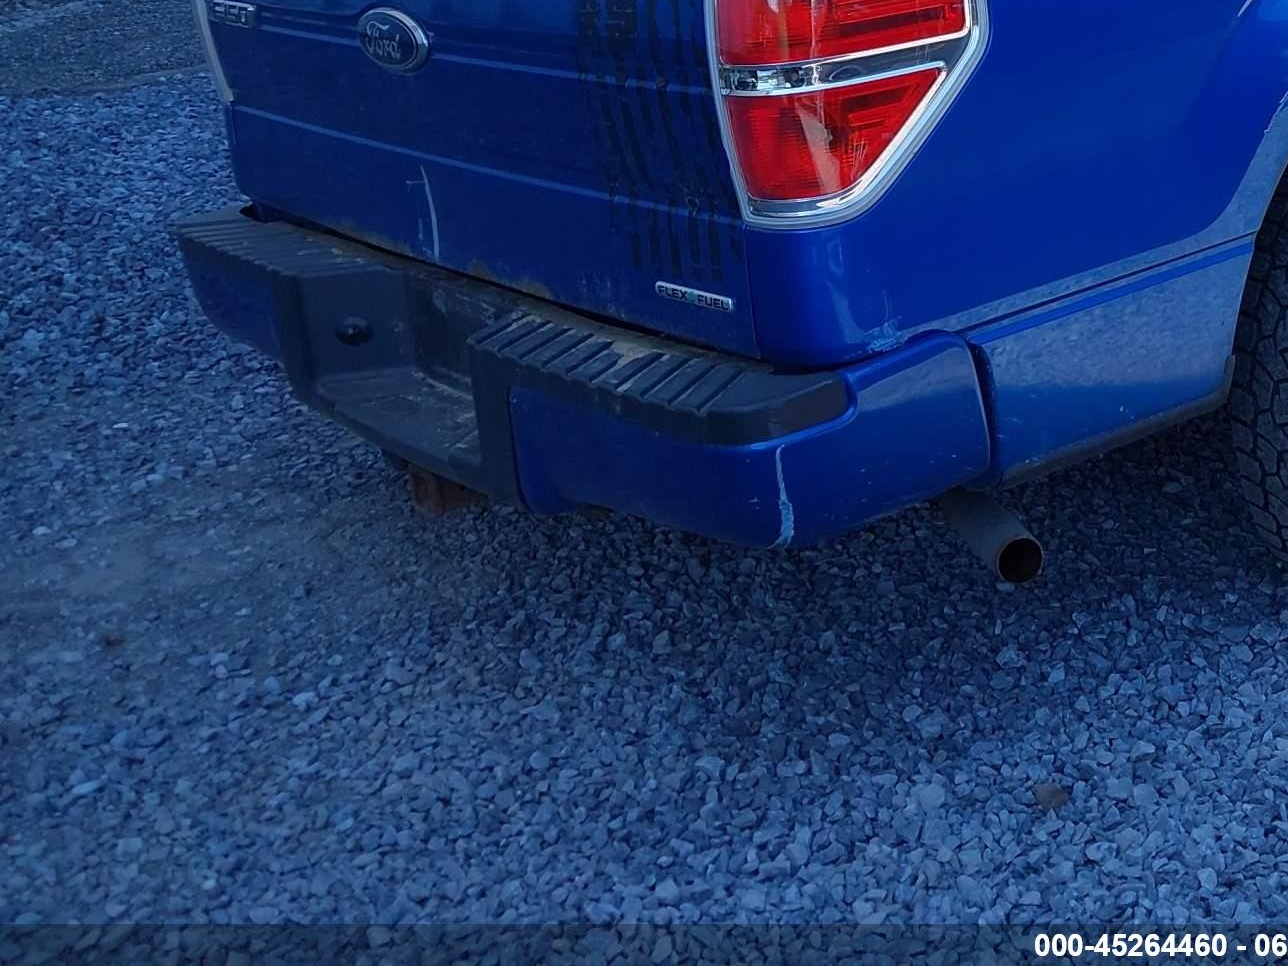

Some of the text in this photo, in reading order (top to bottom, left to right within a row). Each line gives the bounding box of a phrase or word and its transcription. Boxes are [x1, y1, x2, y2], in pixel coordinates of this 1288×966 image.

[364, 19, 402, 59] Ford
[656, 284, 729, 311] FLEX FUEL
